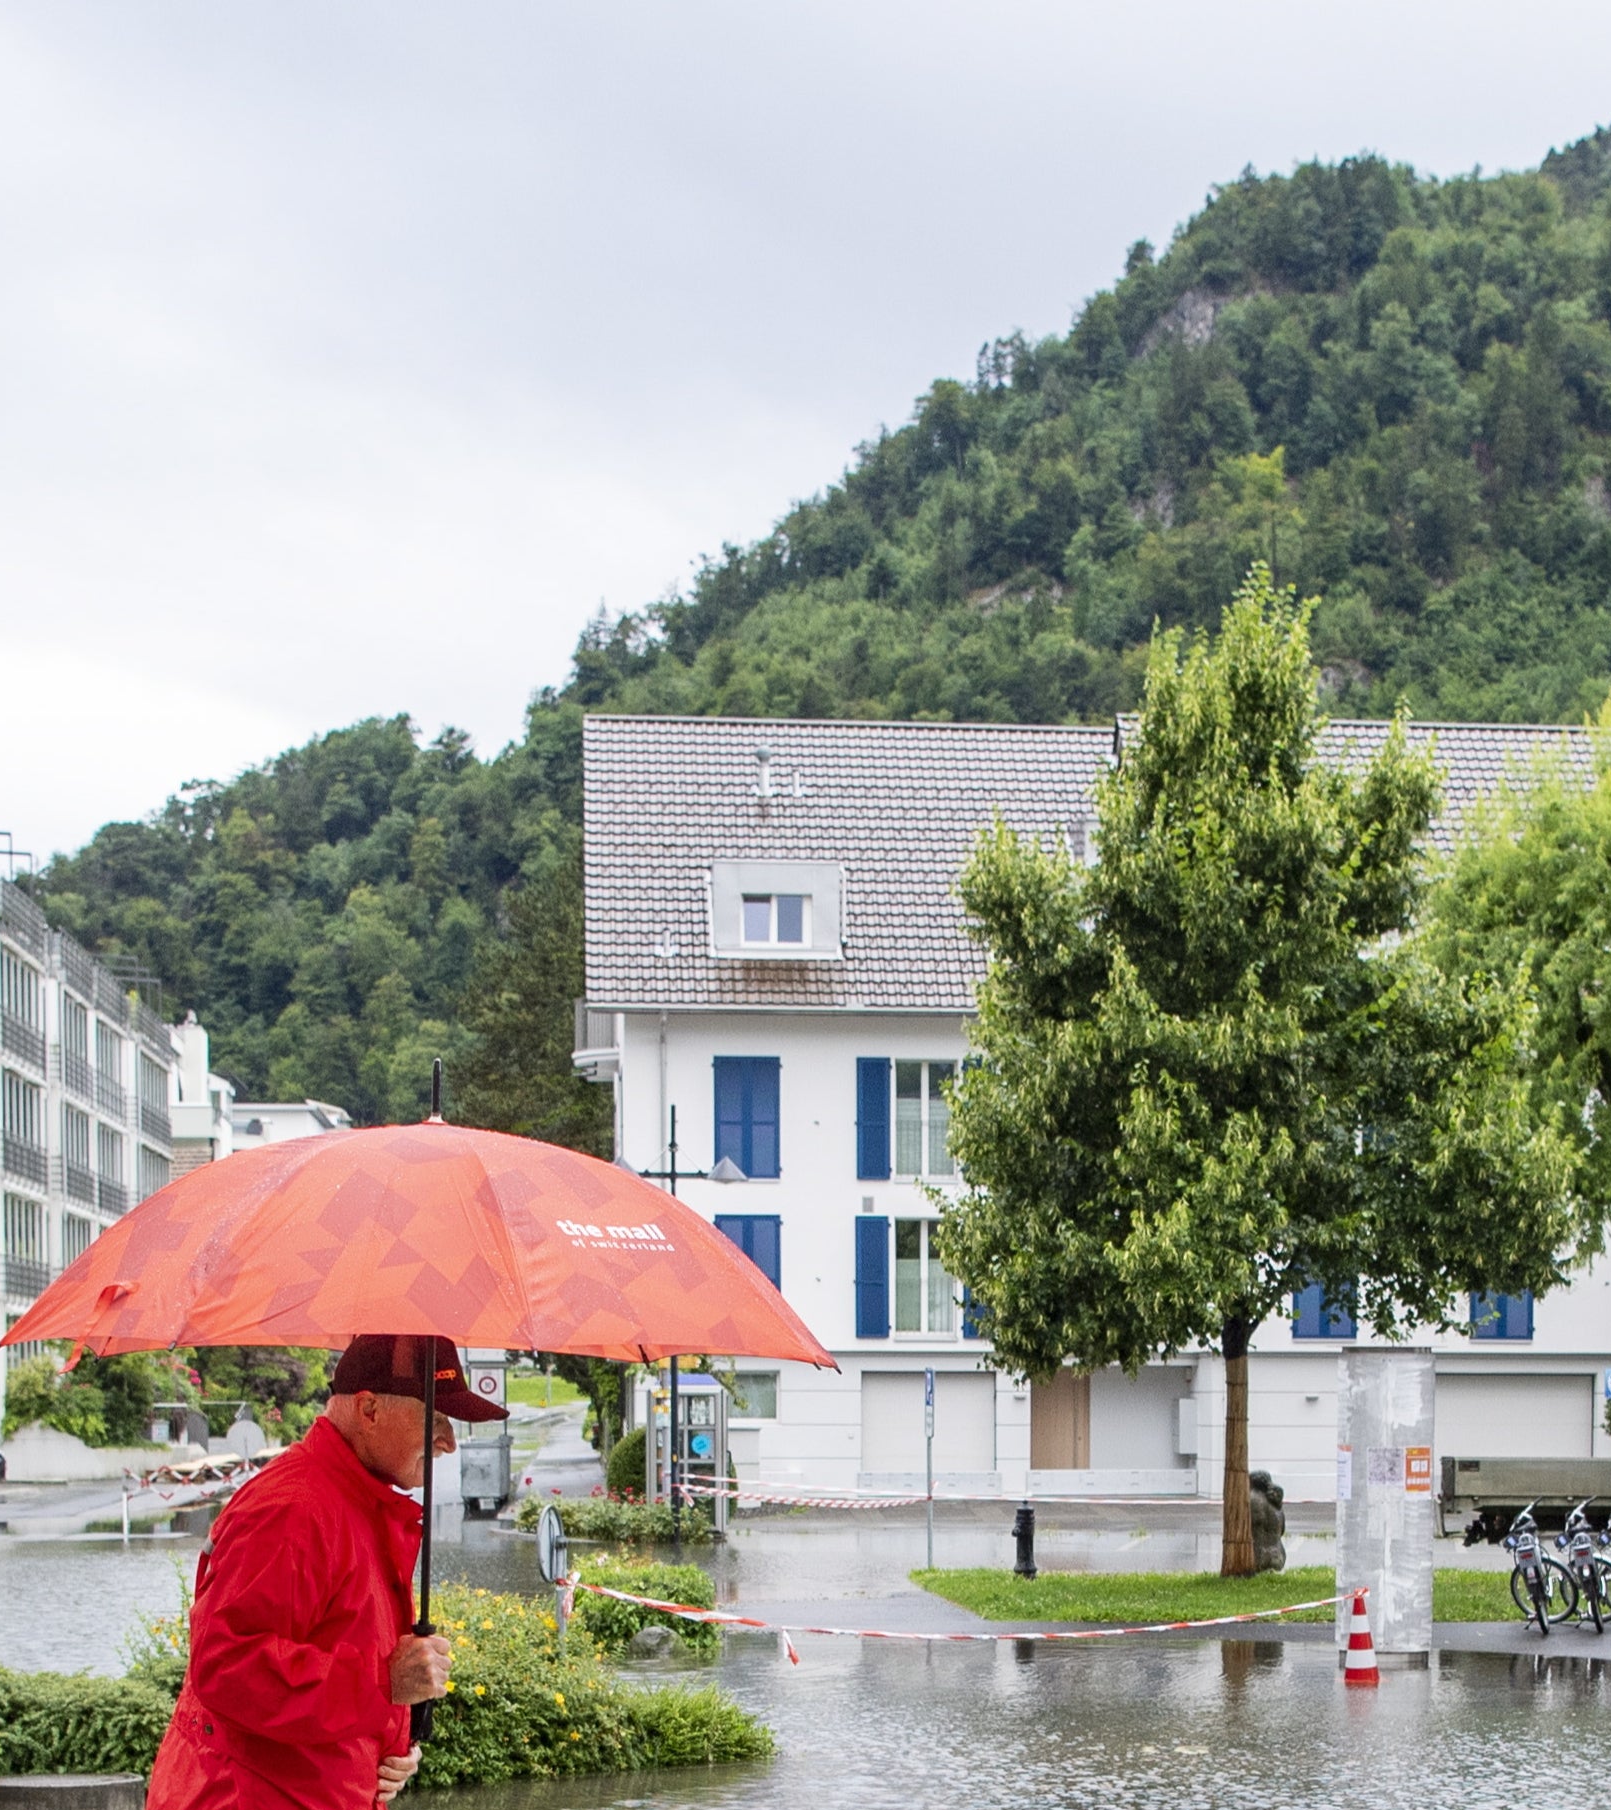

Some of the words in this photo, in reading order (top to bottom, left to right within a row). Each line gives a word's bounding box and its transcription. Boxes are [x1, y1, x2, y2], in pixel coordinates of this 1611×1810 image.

[556, 1219, 603, 1237] the
[605, 1224, 666, 1240] mall
[572, 1238, 586, 1249] of
[590, 1241, 675, 1252] switzerland
